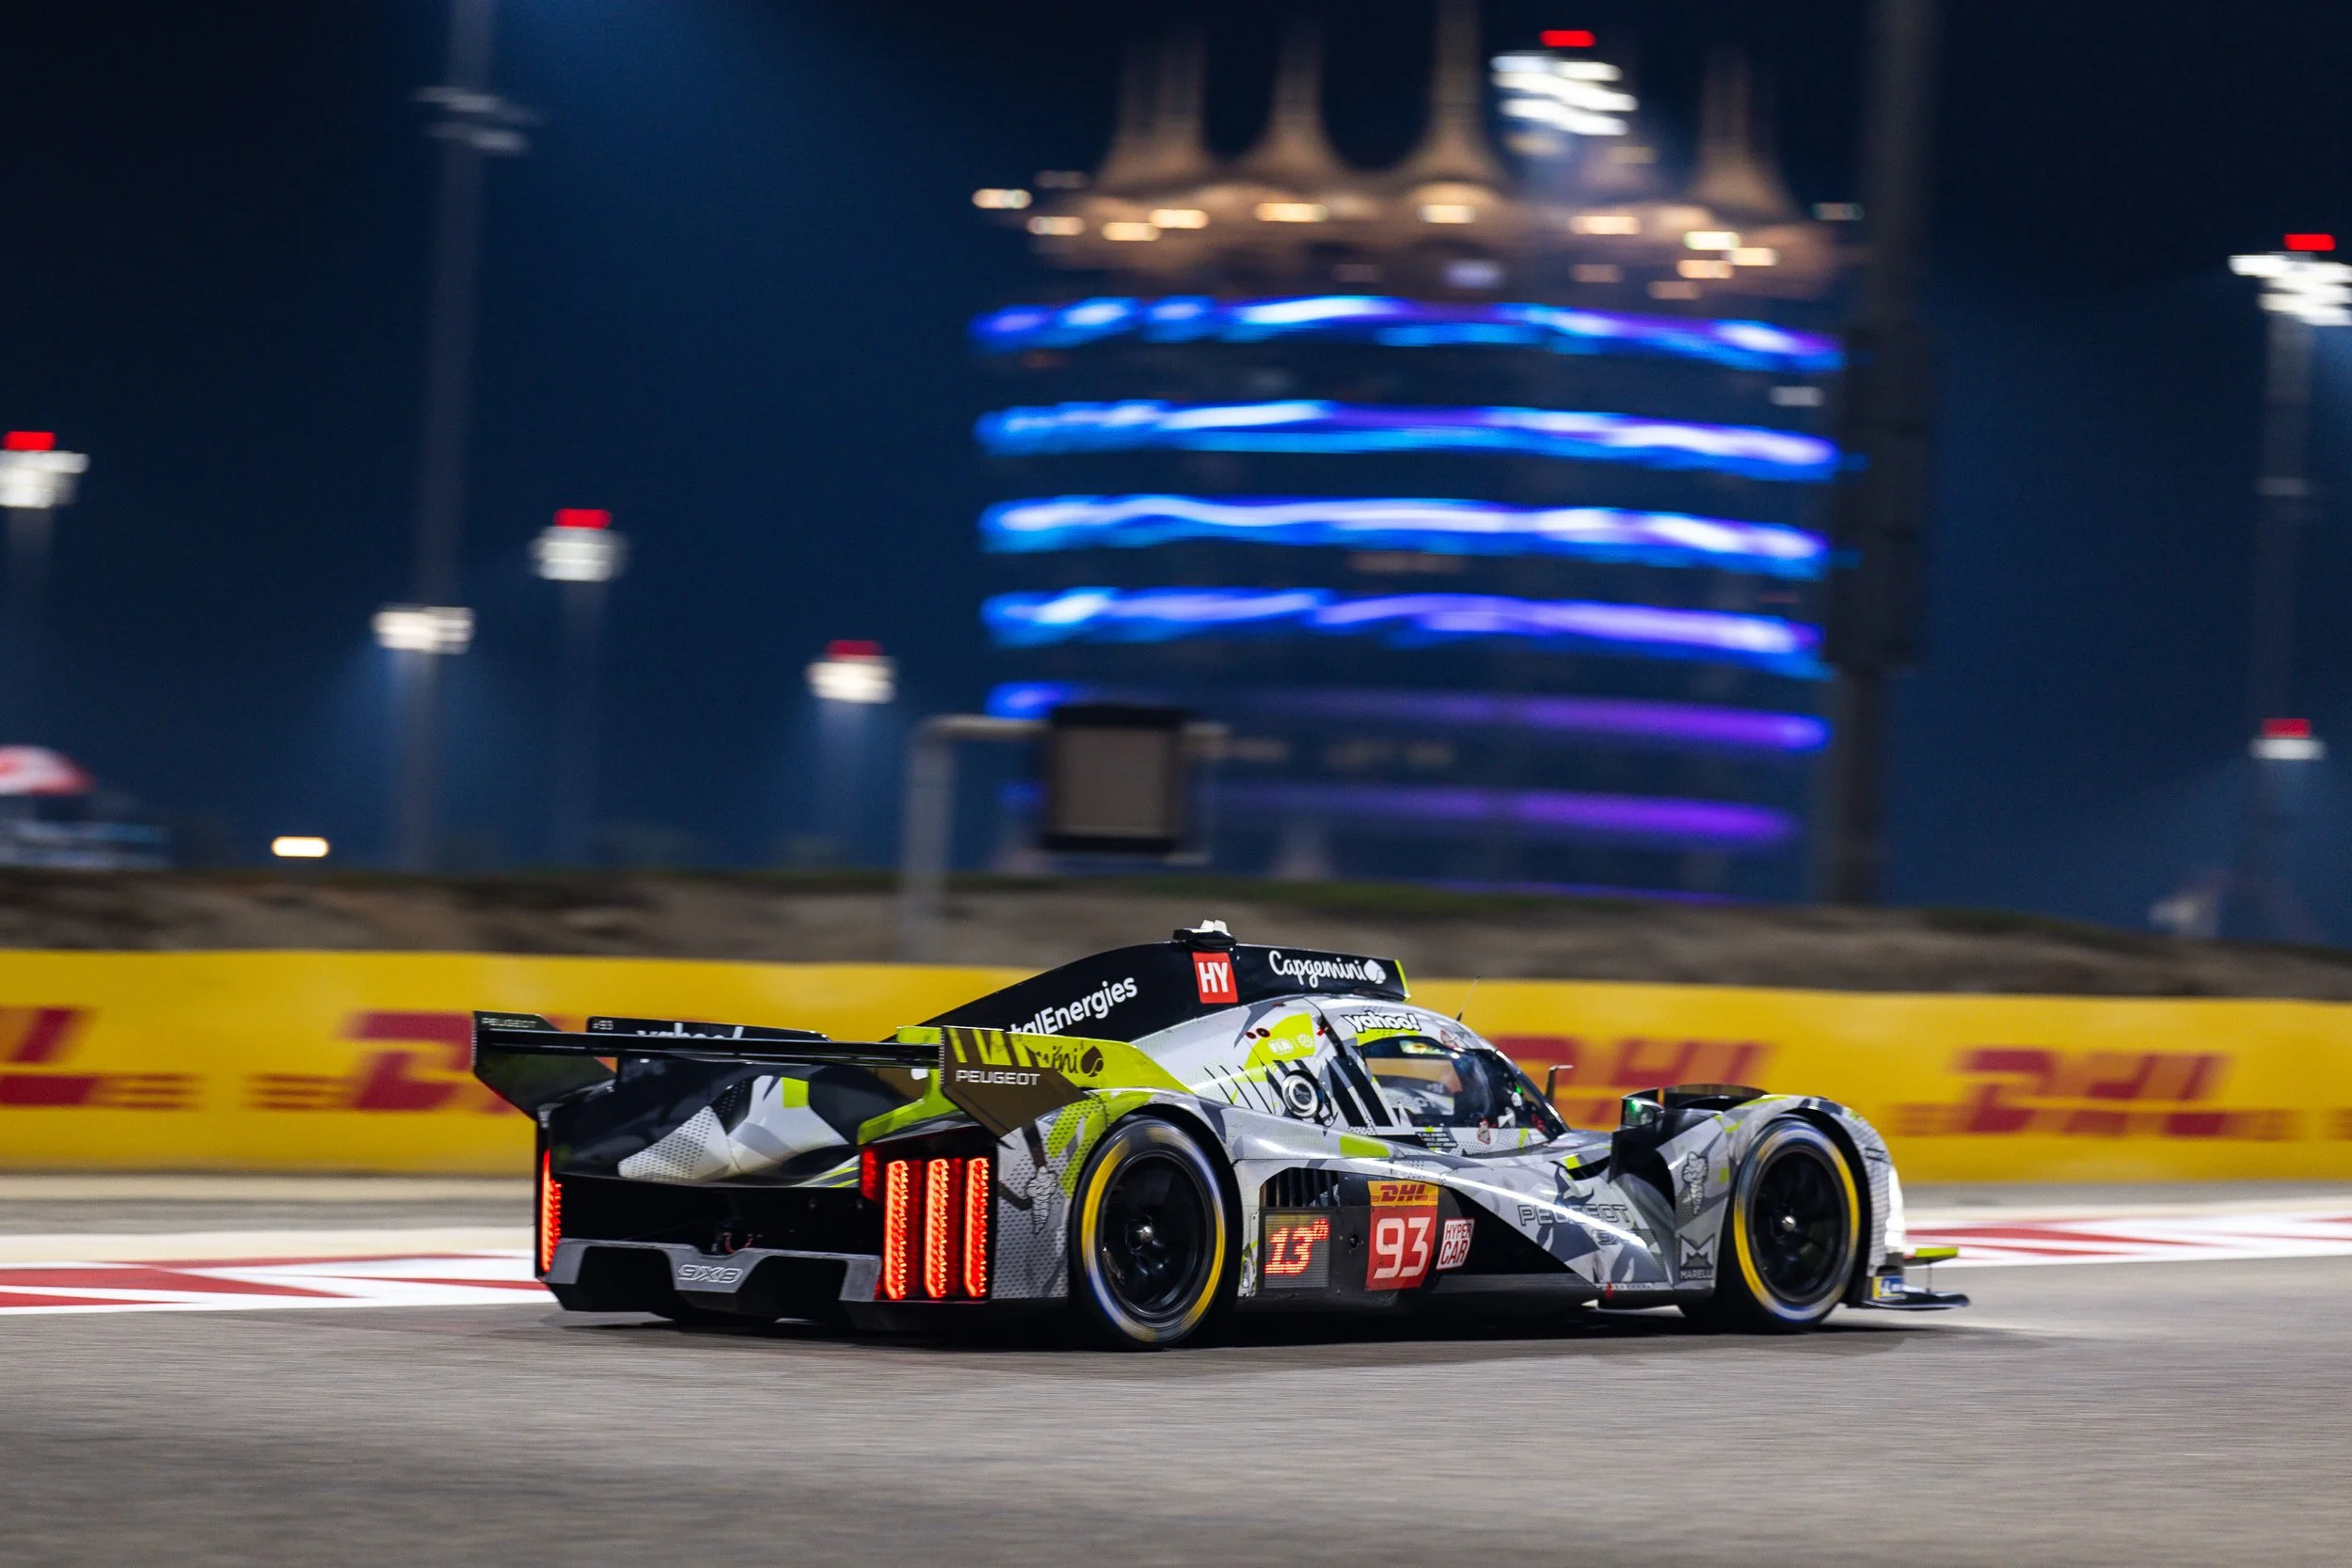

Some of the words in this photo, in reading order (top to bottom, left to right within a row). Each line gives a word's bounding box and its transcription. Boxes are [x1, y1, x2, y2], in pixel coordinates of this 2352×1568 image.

[1198, 961, 1229, 993] HY
[1268, 950, 1366, 988] Capgemini
[481, 1017, 537, 1028] PEUGEOT
[1340, 1009, 1422, 1033] yahoo!
[955, 1069, 1041, 1086] PEUGEOT
[1380, 1183, 1429, 1202] DHL
[1445, 1223, 1472, 1241] HYPER
[1373, 1216, 1431, 1280] 93
[1440, 1239, 1469, 1265] CAR
[677, 1263, 744, 1284] 9X8
